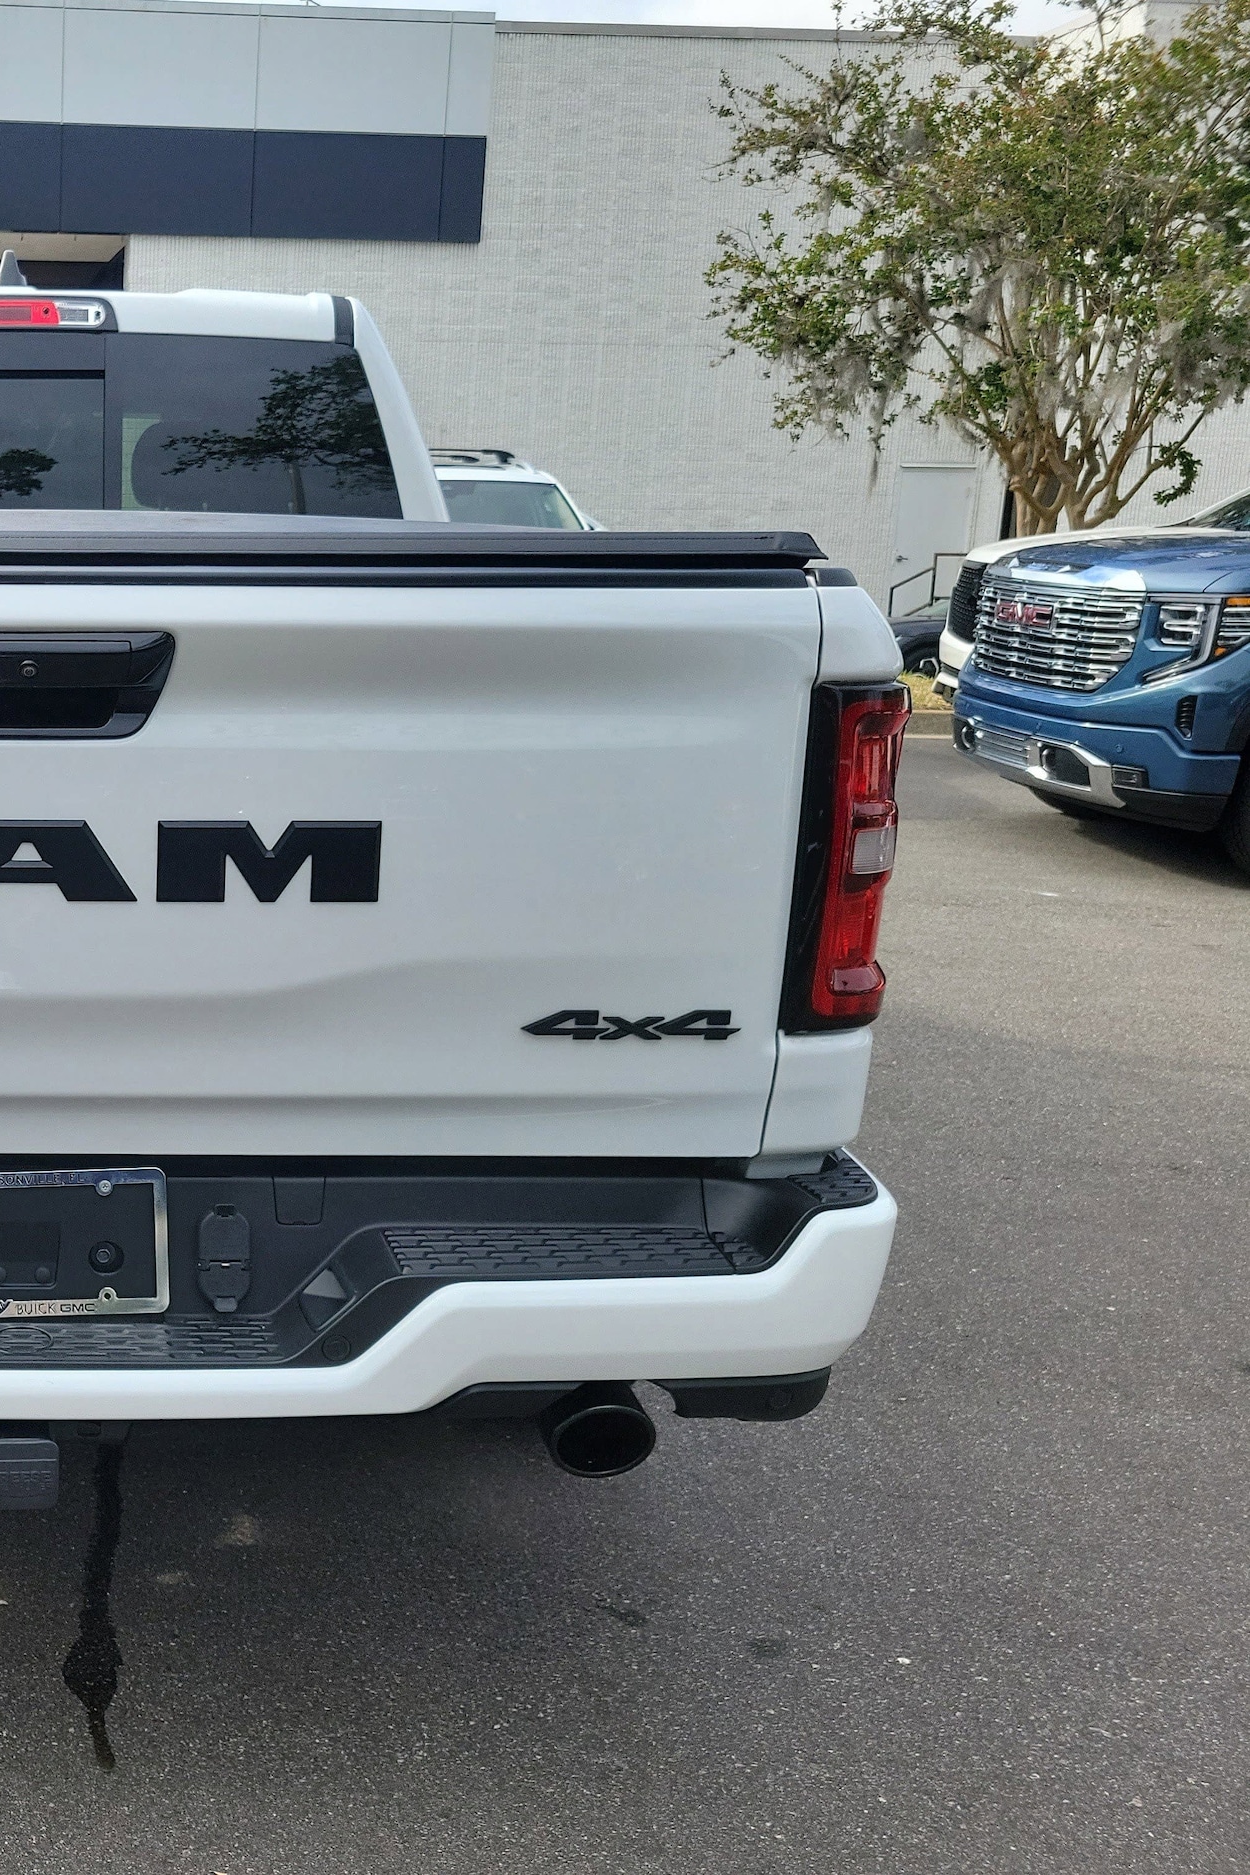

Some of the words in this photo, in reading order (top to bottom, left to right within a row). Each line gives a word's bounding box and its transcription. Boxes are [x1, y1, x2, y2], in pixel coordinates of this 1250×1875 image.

[996, 601, 1052, 627] GMC
[520, 1009, 742, 1040] 4x4
[69, 1172, 85, 1184] FL
[15, 1302, 56, 1315] BUICK
[60, 1303, 96, 1313] GMC
